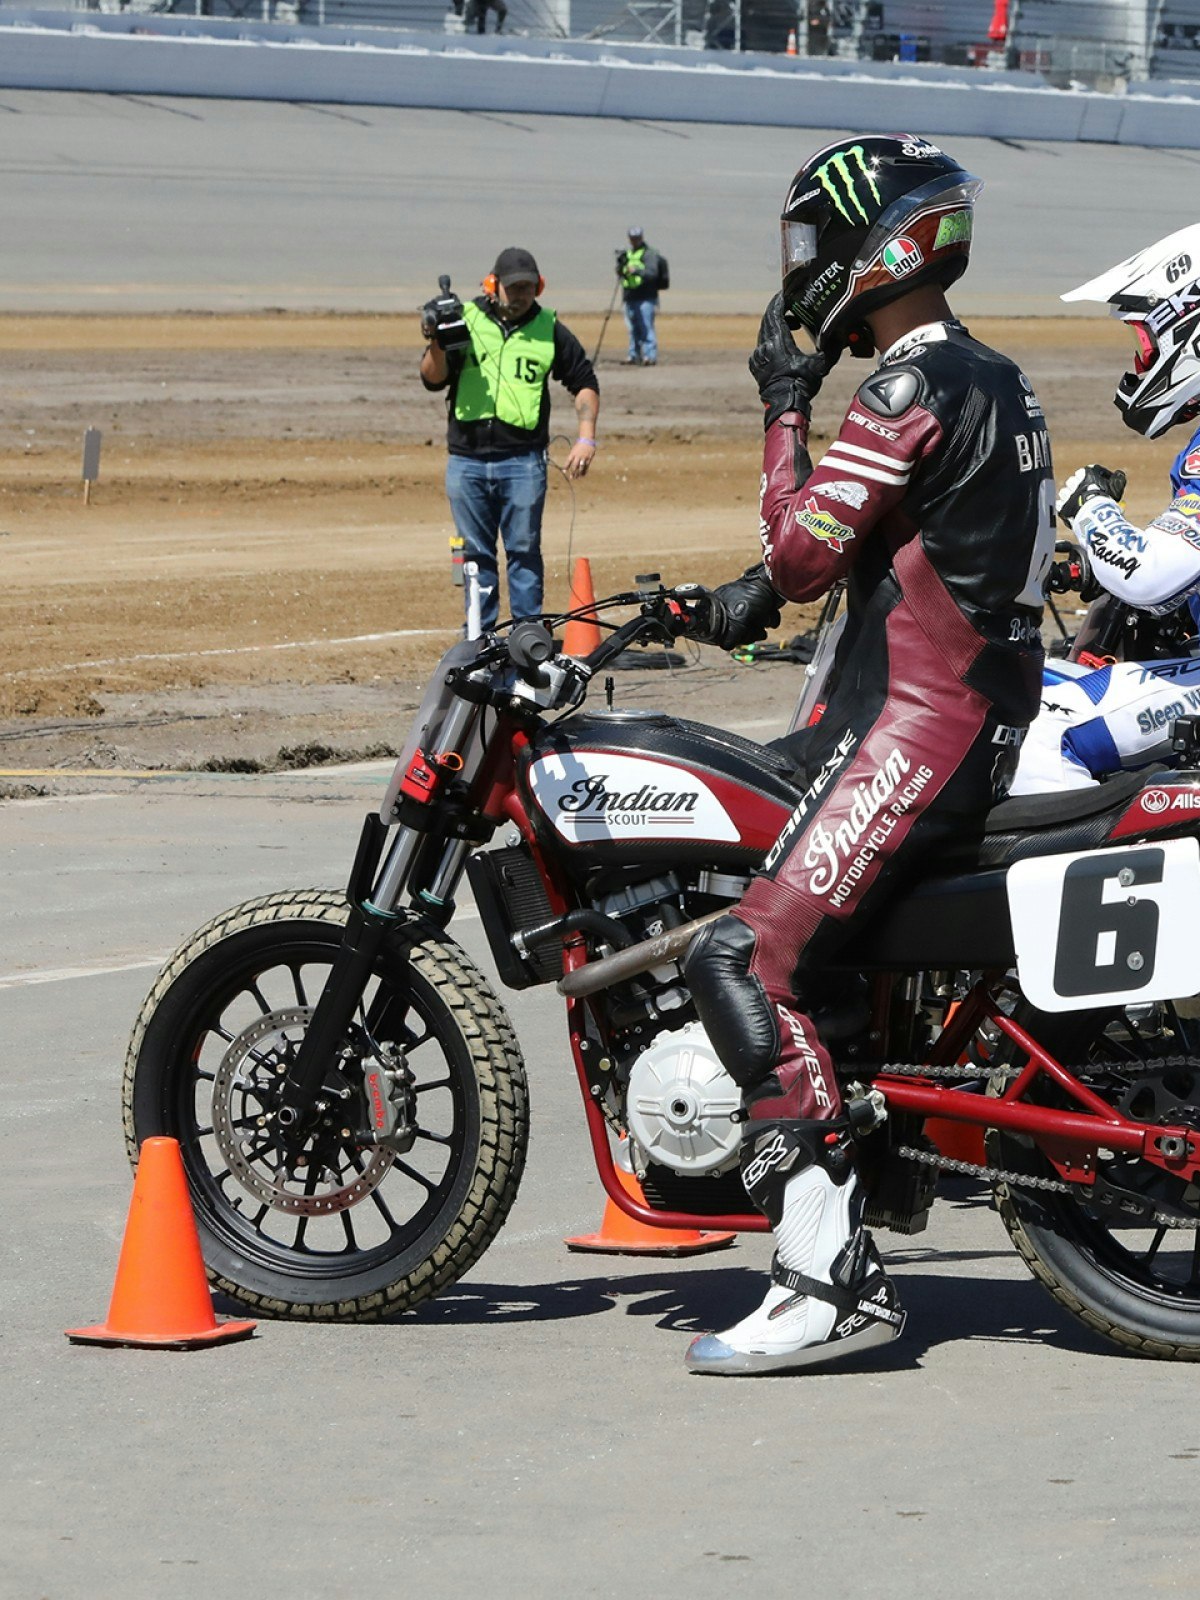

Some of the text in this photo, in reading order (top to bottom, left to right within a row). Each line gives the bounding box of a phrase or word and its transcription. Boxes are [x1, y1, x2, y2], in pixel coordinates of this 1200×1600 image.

[892, 252, 920, 276] agv
[1165, 254, 1193, 284] 69
[514, 357, 540, 384] 15
[848, 410, 901, 442] DAINESE
[800, 513, 848, 537] SUNOCO
[558, 774, 699, 813] Indian
[764, 728, 858, 872] DAINESE
[607, 813, 647, 826] SCOUT
[803, 747, 912, 896] Indian
[829, 763, 934, 909] MOTORCYCLE RACING
[1053, 847, 1165, 998] 6
[776, 1002, 831, 1109] DAINESE
[369, 1072, 386, 1129] brembo
